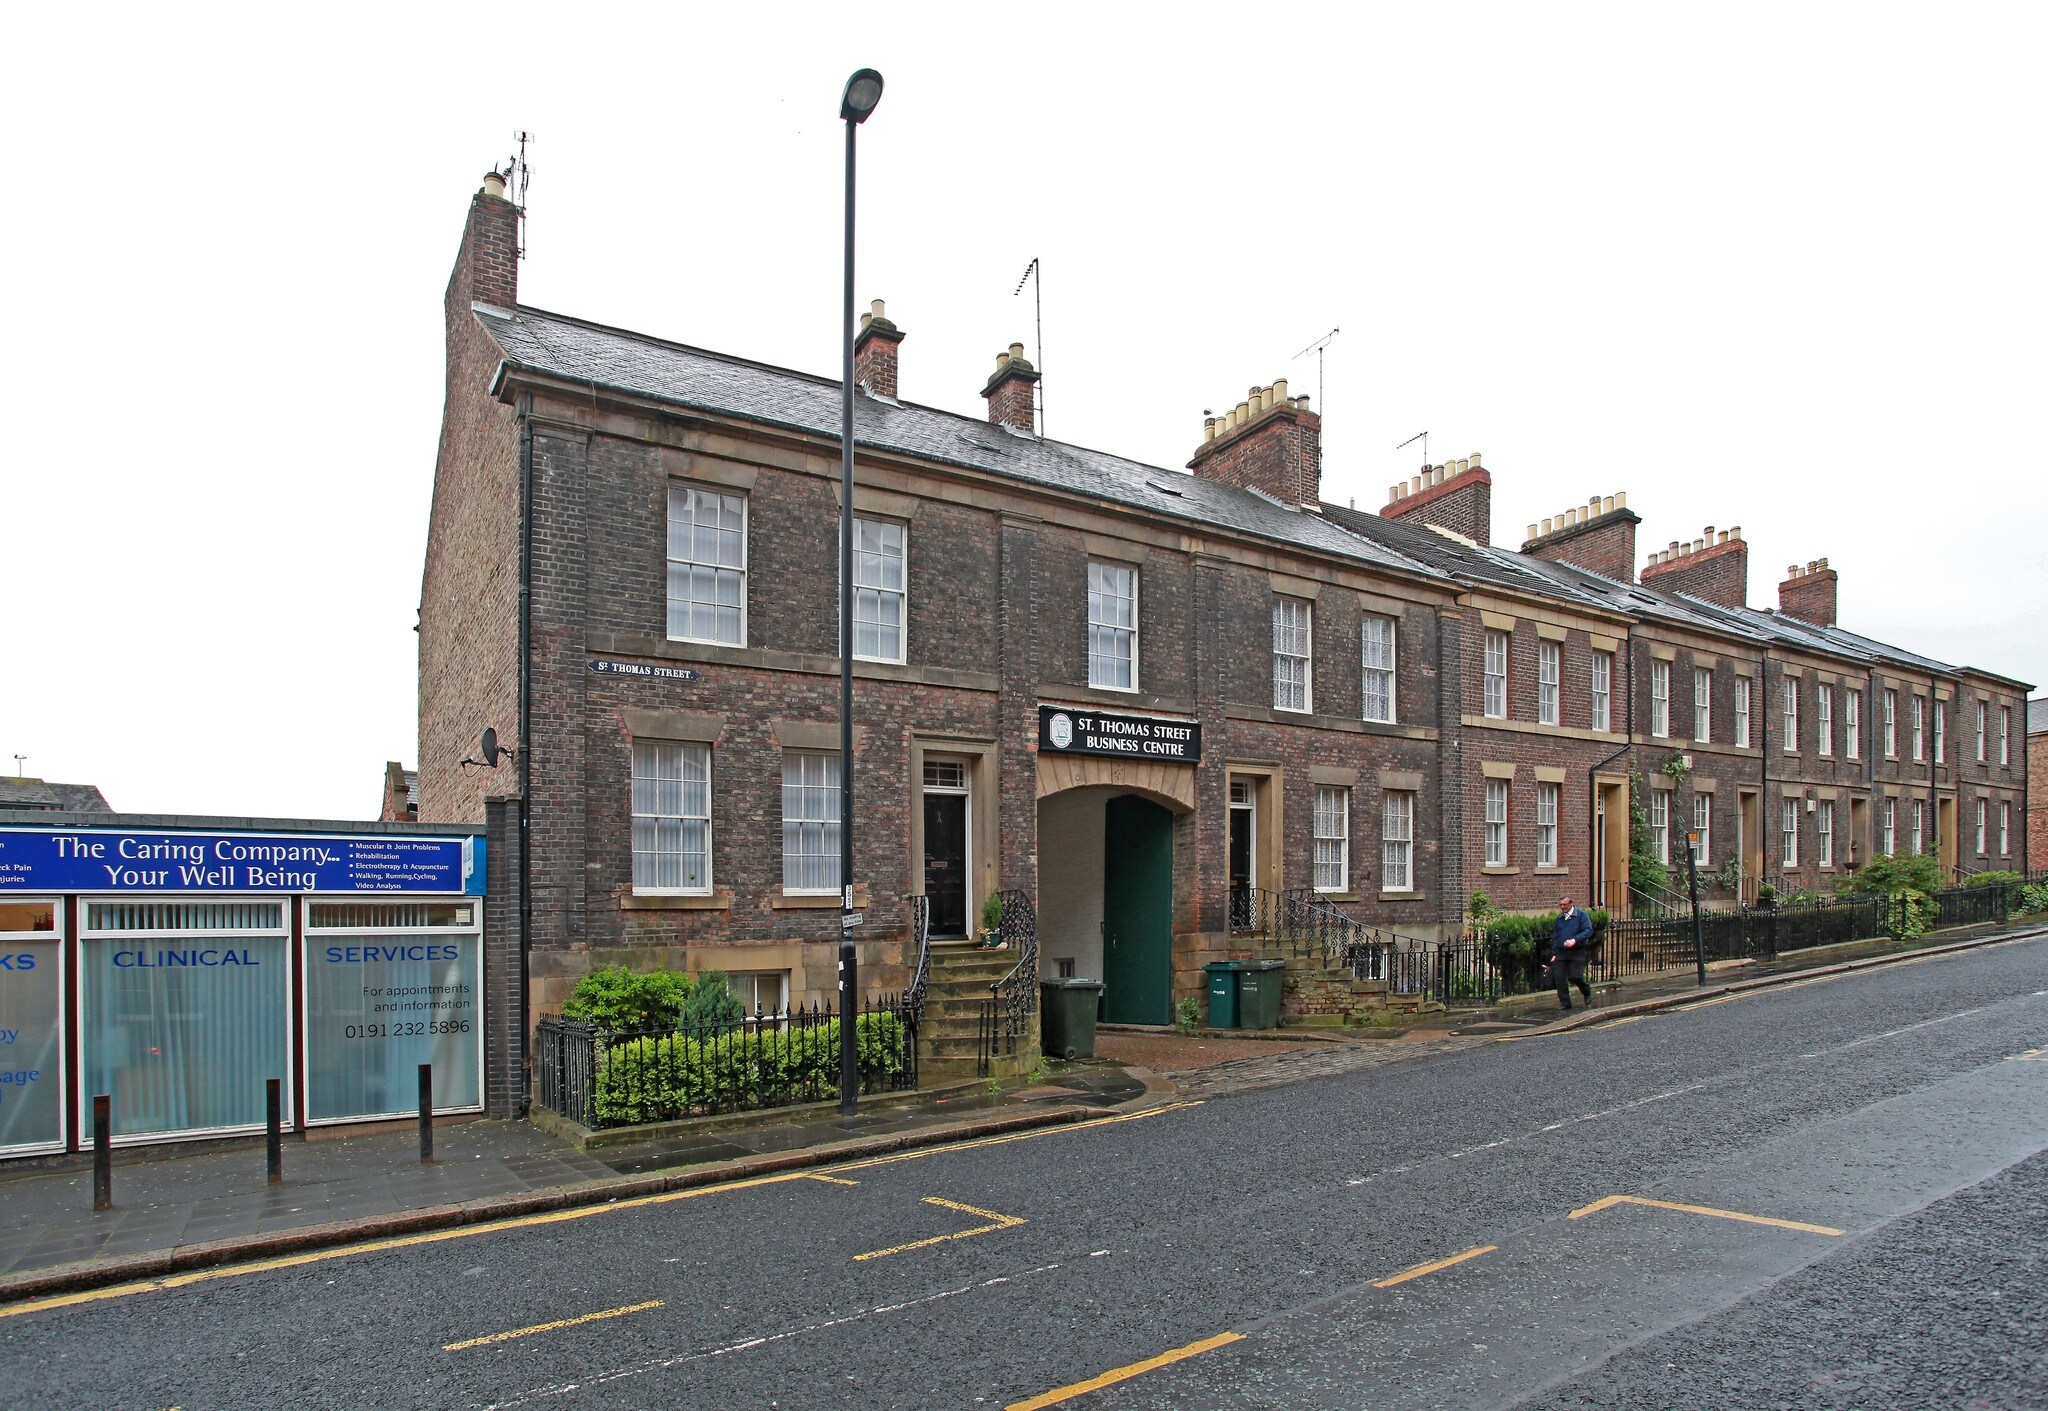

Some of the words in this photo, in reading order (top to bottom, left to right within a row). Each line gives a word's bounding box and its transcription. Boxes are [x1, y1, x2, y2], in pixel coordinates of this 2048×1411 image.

[612, 663, 651, 675] THOMAS
[1078, 718, 1095, 731] ST.
[1099, 720, 1150, 737] THOMAS
[1153, 726, 1192, 741] STREET
[1086, 735, 1139, 752] BUSINESS
[1143, 741, 1184, 756] CENTRE
[52, 837, 105, 858] The
[119, 838, 205, 865] Caring
[215, 840, 340, 866] Company...
[355, 863, 401, 871] Electrotherapy
[103, 864, 168, 886] Your
[178, 865, 234, 886] Well
[246, 866, 317, 891] Being
[113, 950, 260, 968] CLINICAL
[326, 945, 459, 963] SERVICES
[363, 986, 384, 997] For
[386, 983, 470, 998] appointments
[374, 1002, 398, 1012] and
[400, 1000, 470, 1011] information
[345, 1023, 387, 1039] 0191
[393, 1022, 425, 1037] 232
[429, 1019, 470, 1035] 5896
